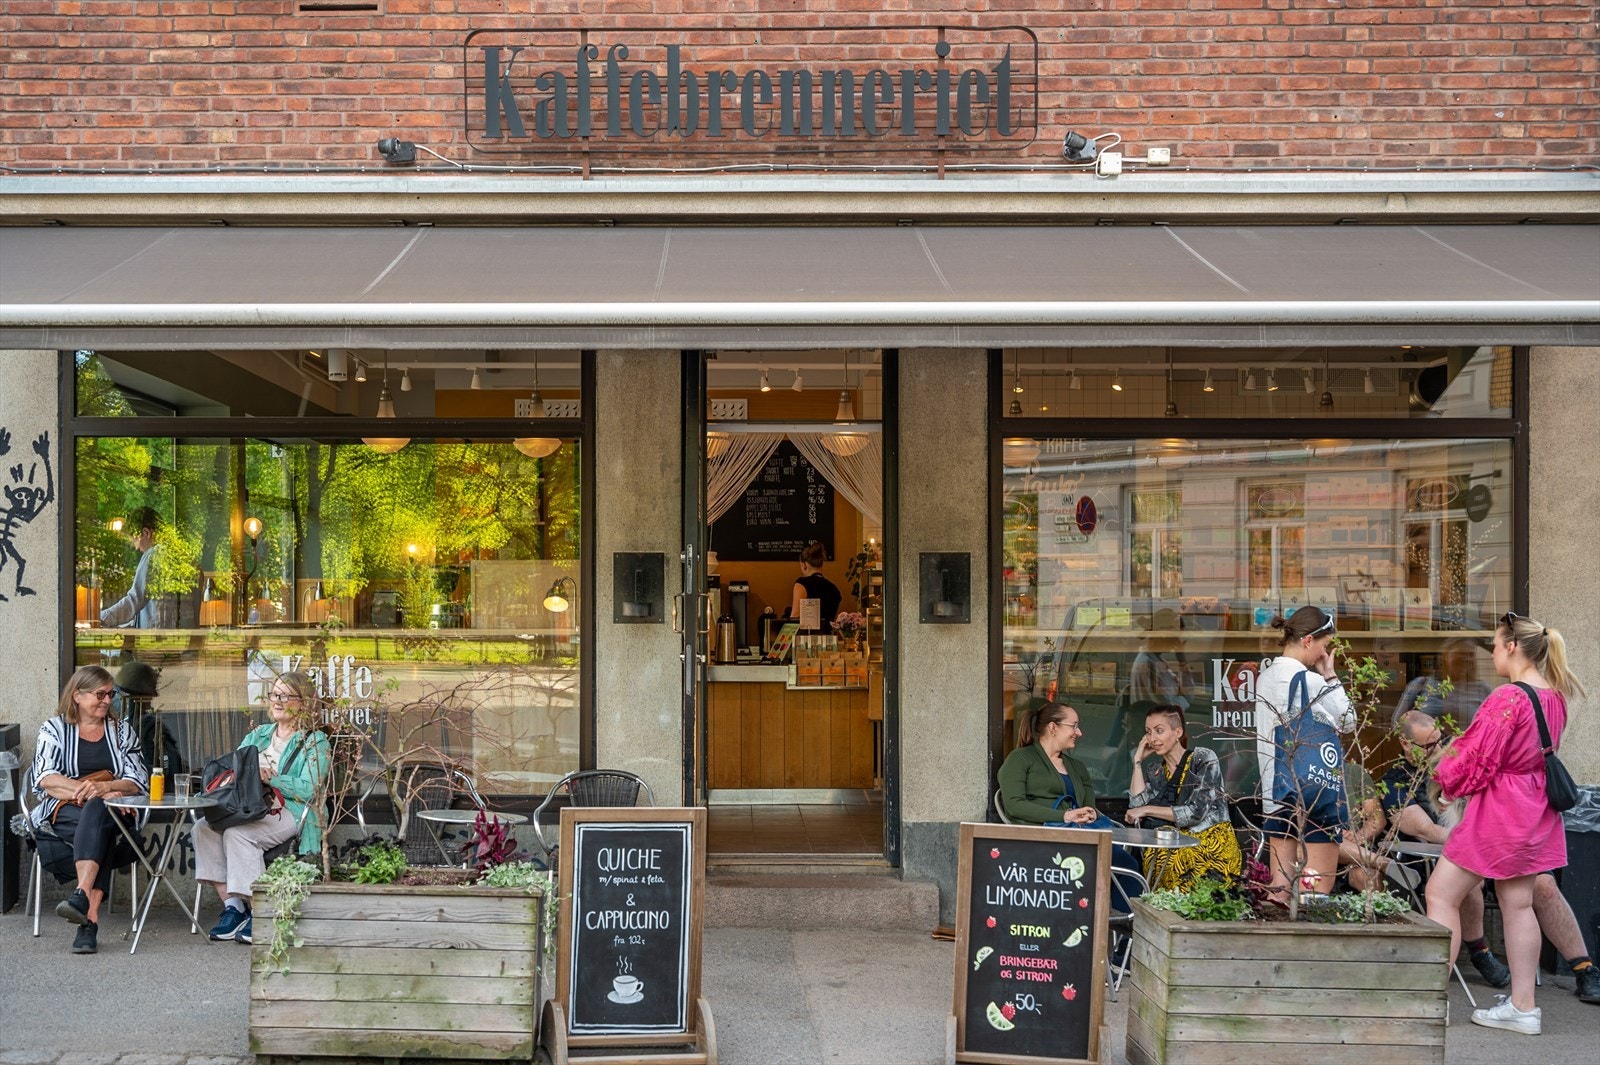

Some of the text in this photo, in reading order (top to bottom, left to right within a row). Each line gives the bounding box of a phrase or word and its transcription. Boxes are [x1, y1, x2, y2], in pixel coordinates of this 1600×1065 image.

[482, 41, 1021, 139] Kaffebrenneriet
[597, 847, 662, 872] QUICHE
[647, 874, 666, 886] feta
[998, 862, 1070, 885] VÅR EGEN
[625, 893, 636, 907] &
[986, 885, 1073, 911] LIMONADE
[585, 910, 670, 930] CAPPUCCINO
[1010, 924, 1051, 938] SITRON
[613, 935, 626, 947] fra
[1019, 943, 1040, 952] ELLER
[999, 955, 1058, 970] BRINGEBÆR
[1000, 970, 1052, 982] OG SITRON
